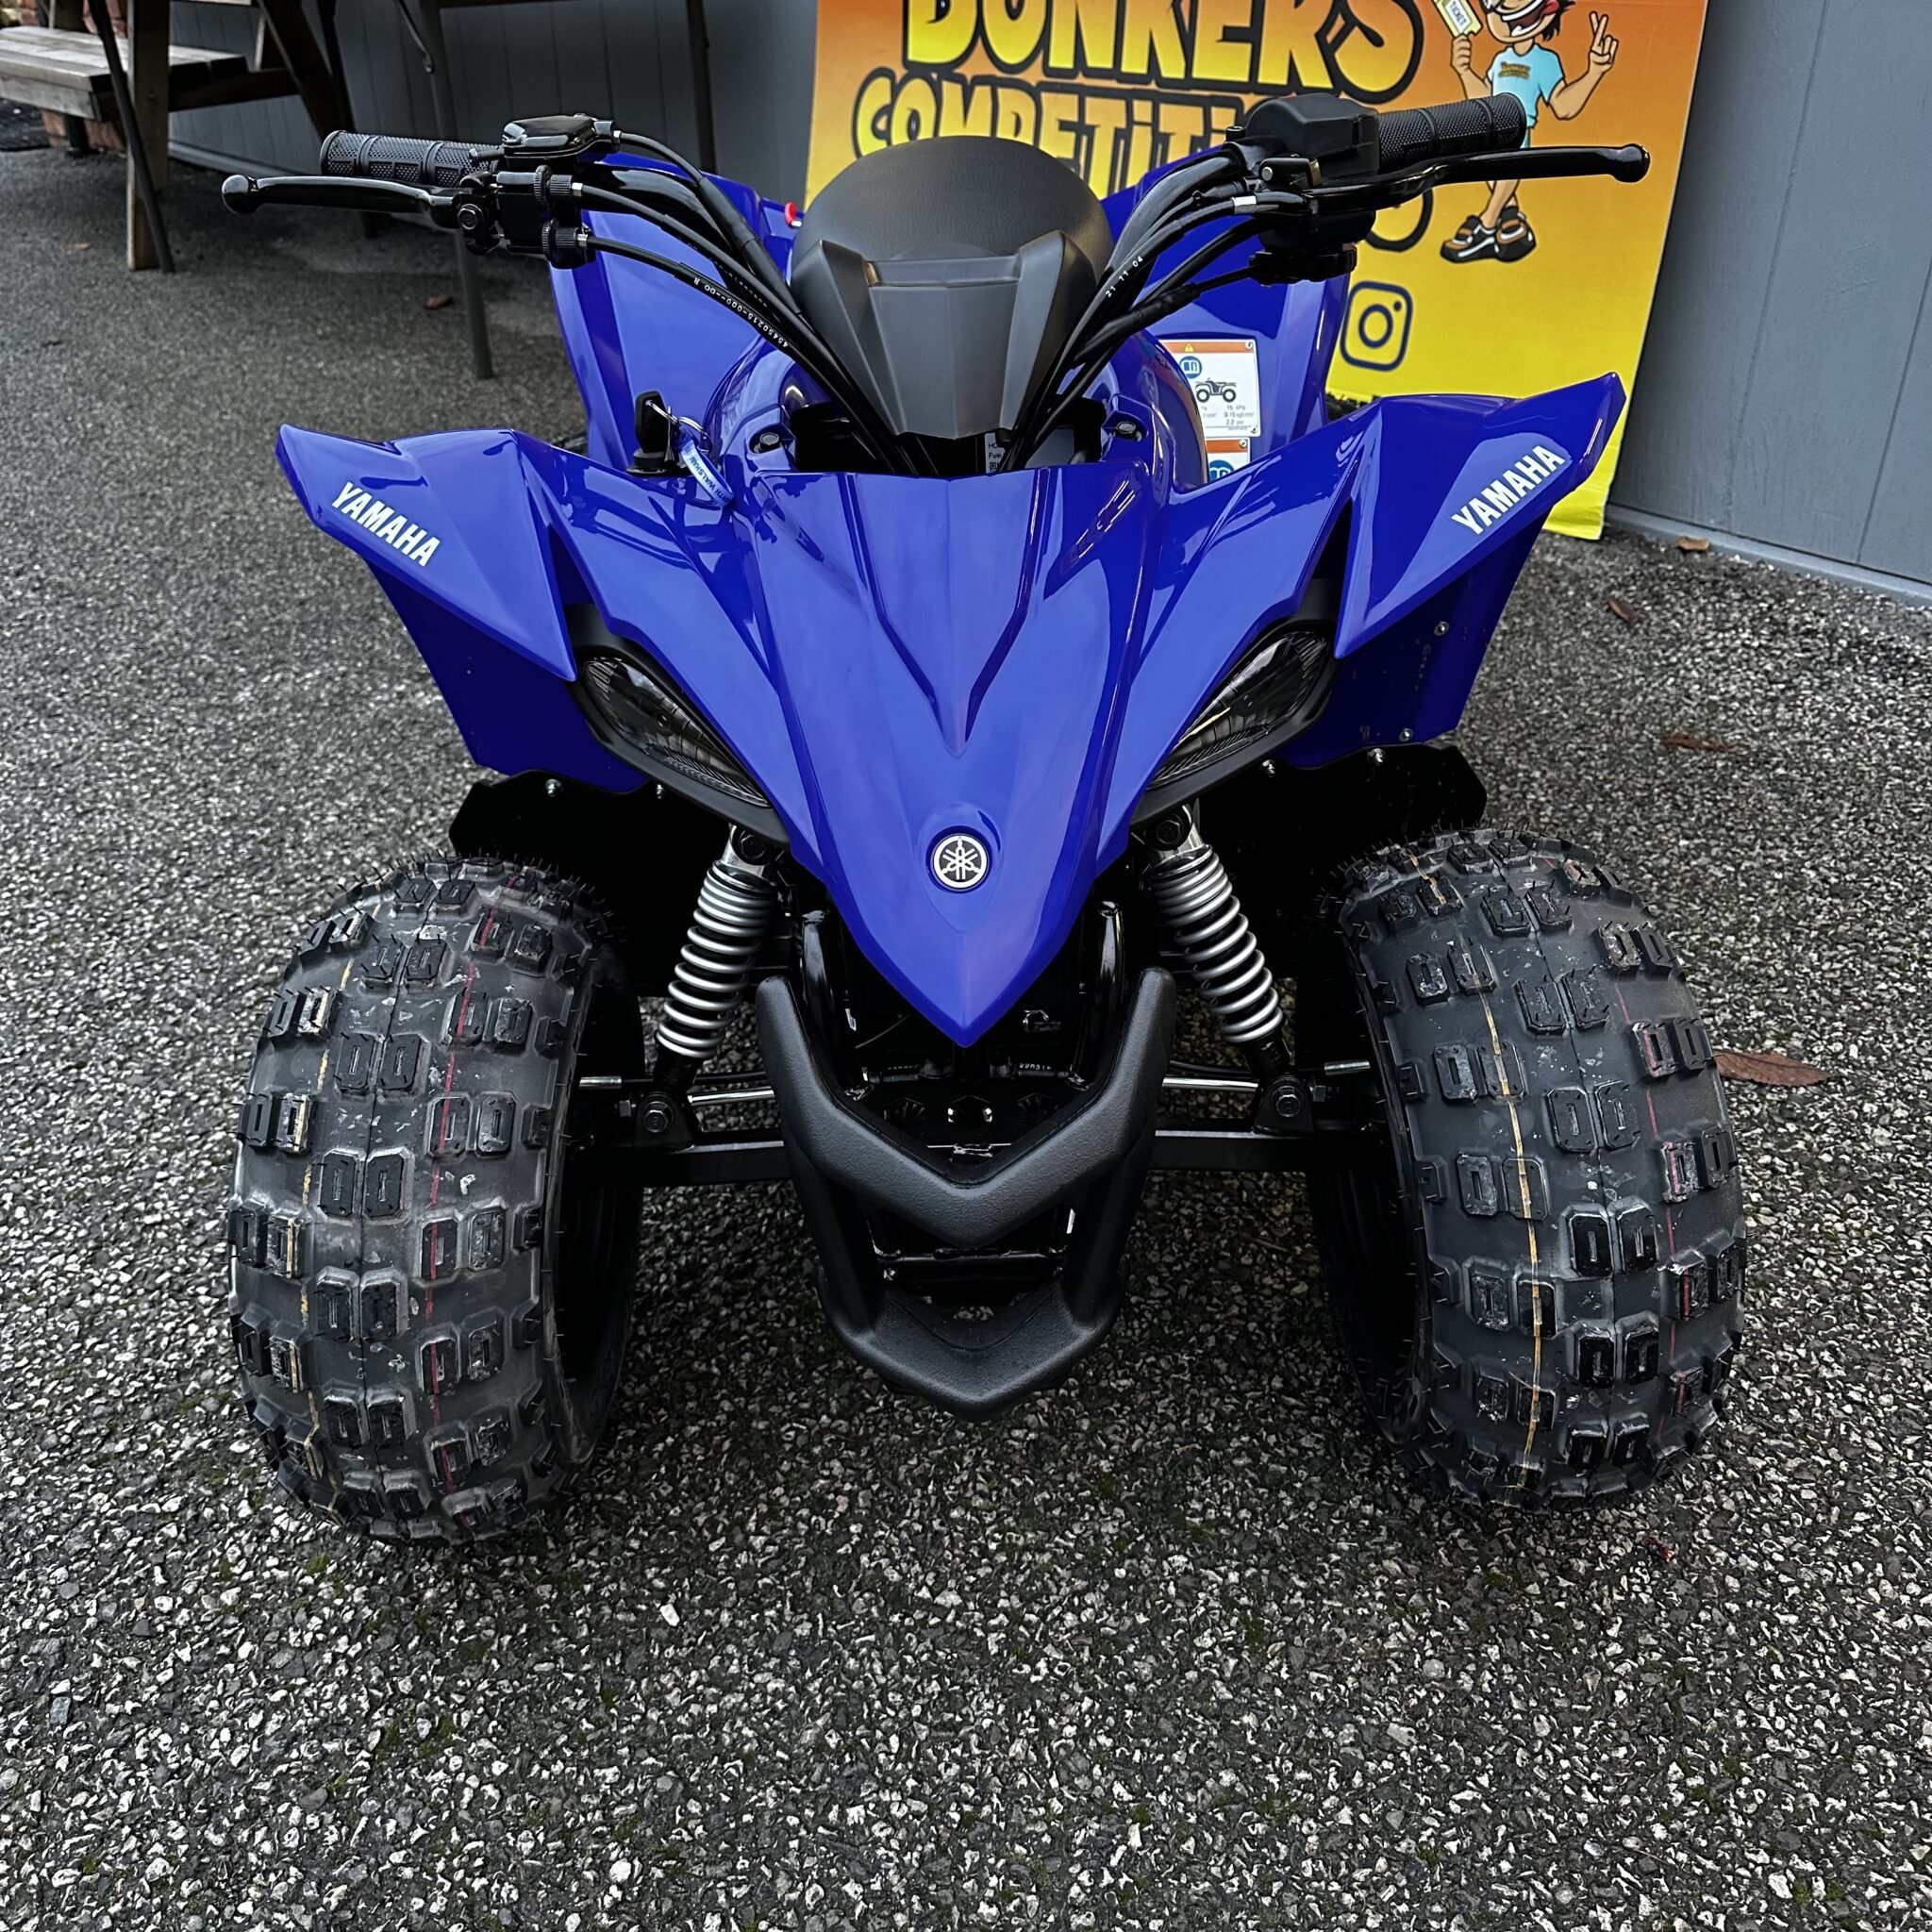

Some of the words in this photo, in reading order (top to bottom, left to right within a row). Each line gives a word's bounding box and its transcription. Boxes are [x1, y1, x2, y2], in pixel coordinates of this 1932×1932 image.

[1132, 255, 1143, 268] 04
[331, 481, 441, 567] YAMAHA
[1451, 445, 1566, 535] YAMAHA
